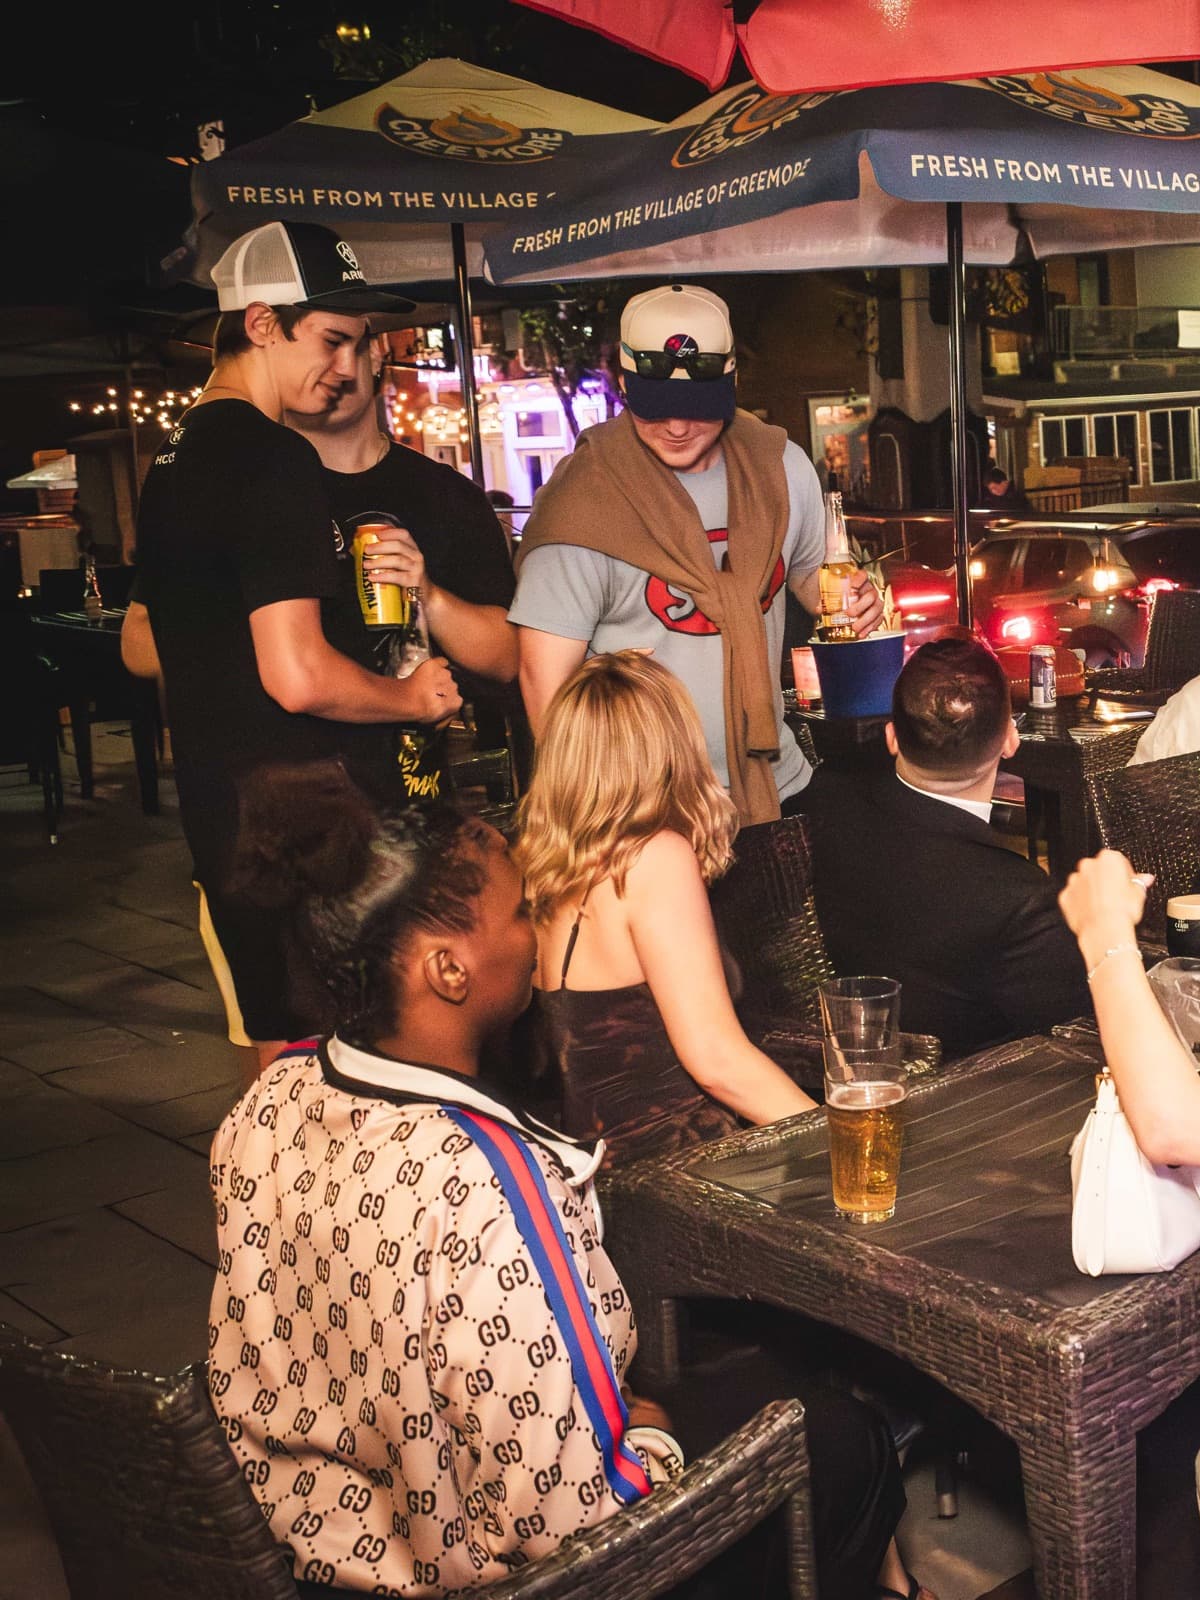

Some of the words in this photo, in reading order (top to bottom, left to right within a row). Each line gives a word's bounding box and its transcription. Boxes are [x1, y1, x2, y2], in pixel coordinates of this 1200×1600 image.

[388, 119, 564, 160] CREEMORE
[910, 155, 989, 180] FRESH
[993, 158, 1062, 184] FROM
[1067, 164, 1115, 188] THE
[227, 185, 304, 206] FRESH
[313, 188, 383, 208] FROM
[389, 191, 435, 208] THE
[442, 192, 539, 208] VILLAGE
[512, 228, 562, 255] FRESH
[567, 216, 612, 244] FROM
[614, 209, 643, 231] THE
[644, 193, 703, 222] VILLAGE
[706, 182, 728, 204] OF
[729, 158, 811, 198] CREEMORE
[361, 567, 378, 610] TWISTE
